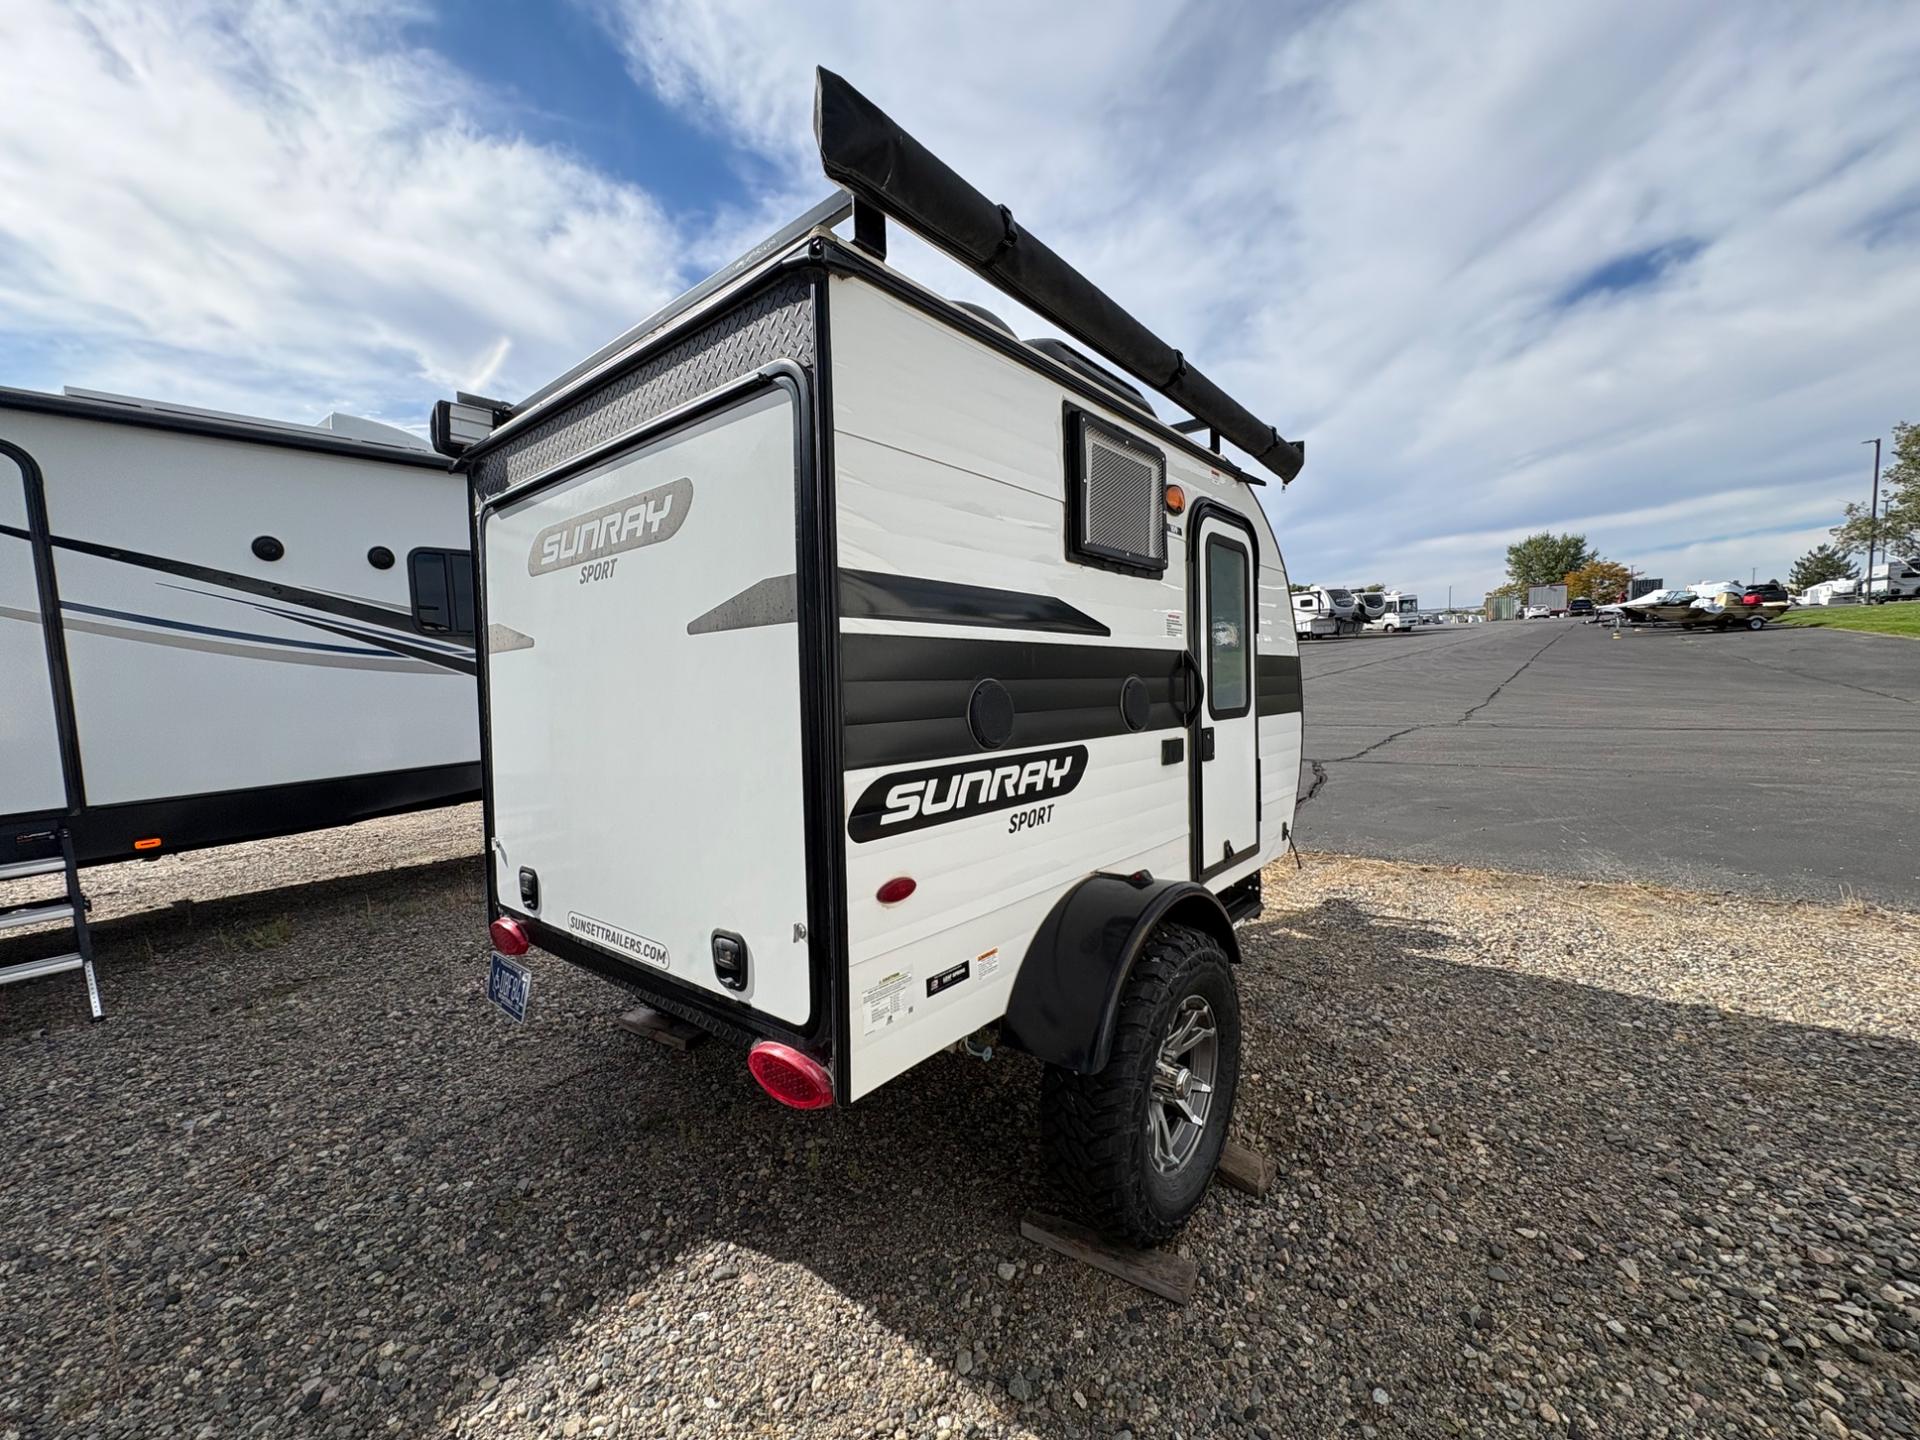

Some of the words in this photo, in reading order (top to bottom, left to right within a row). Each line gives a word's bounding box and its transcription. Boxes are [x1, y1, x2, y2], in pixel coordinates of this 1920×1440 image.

[541, 495, 673, 566] SUNRAY
[579, 557, 618, 585] SPORT
[880, 755, 1073, 826] SUNRAY
[1008, 803, 1055, 834] SPORT
[570, 916, 667, 964] SUNSETTRAILERS.COM
